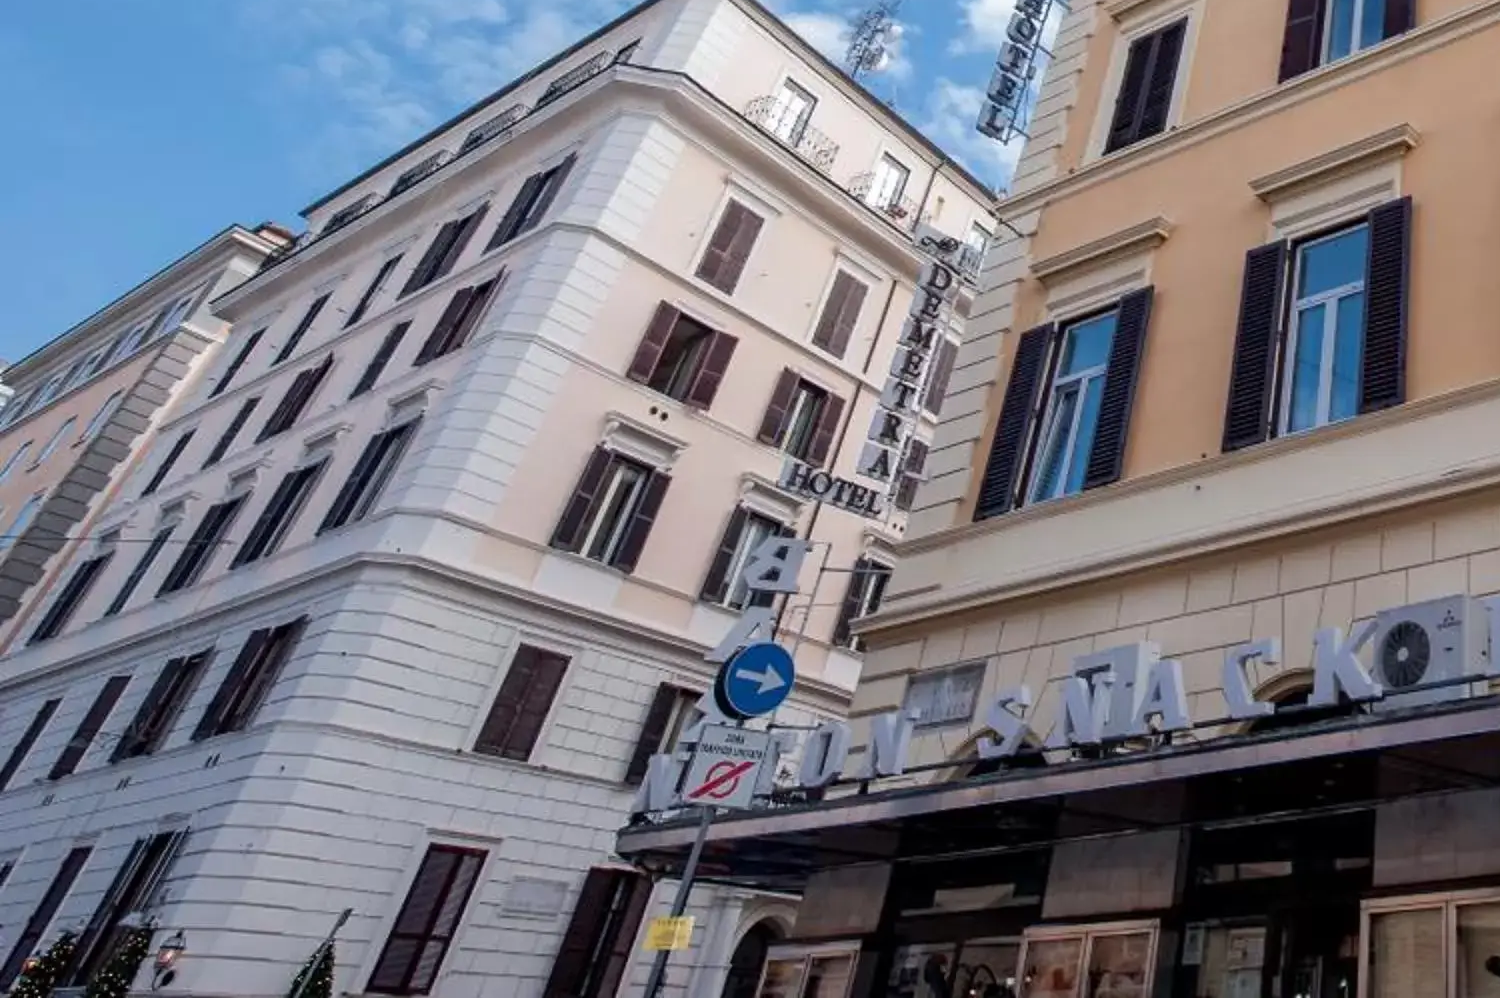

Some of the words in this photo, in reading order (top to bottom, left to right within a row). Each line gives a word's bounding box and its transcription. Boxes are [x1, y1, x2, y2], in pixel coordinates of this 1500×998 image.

[866, 264, 953, 479] DEMETRA
[786, 462, 882, 516] HOTEL
[976, 617, 1391, 759] SNACK
